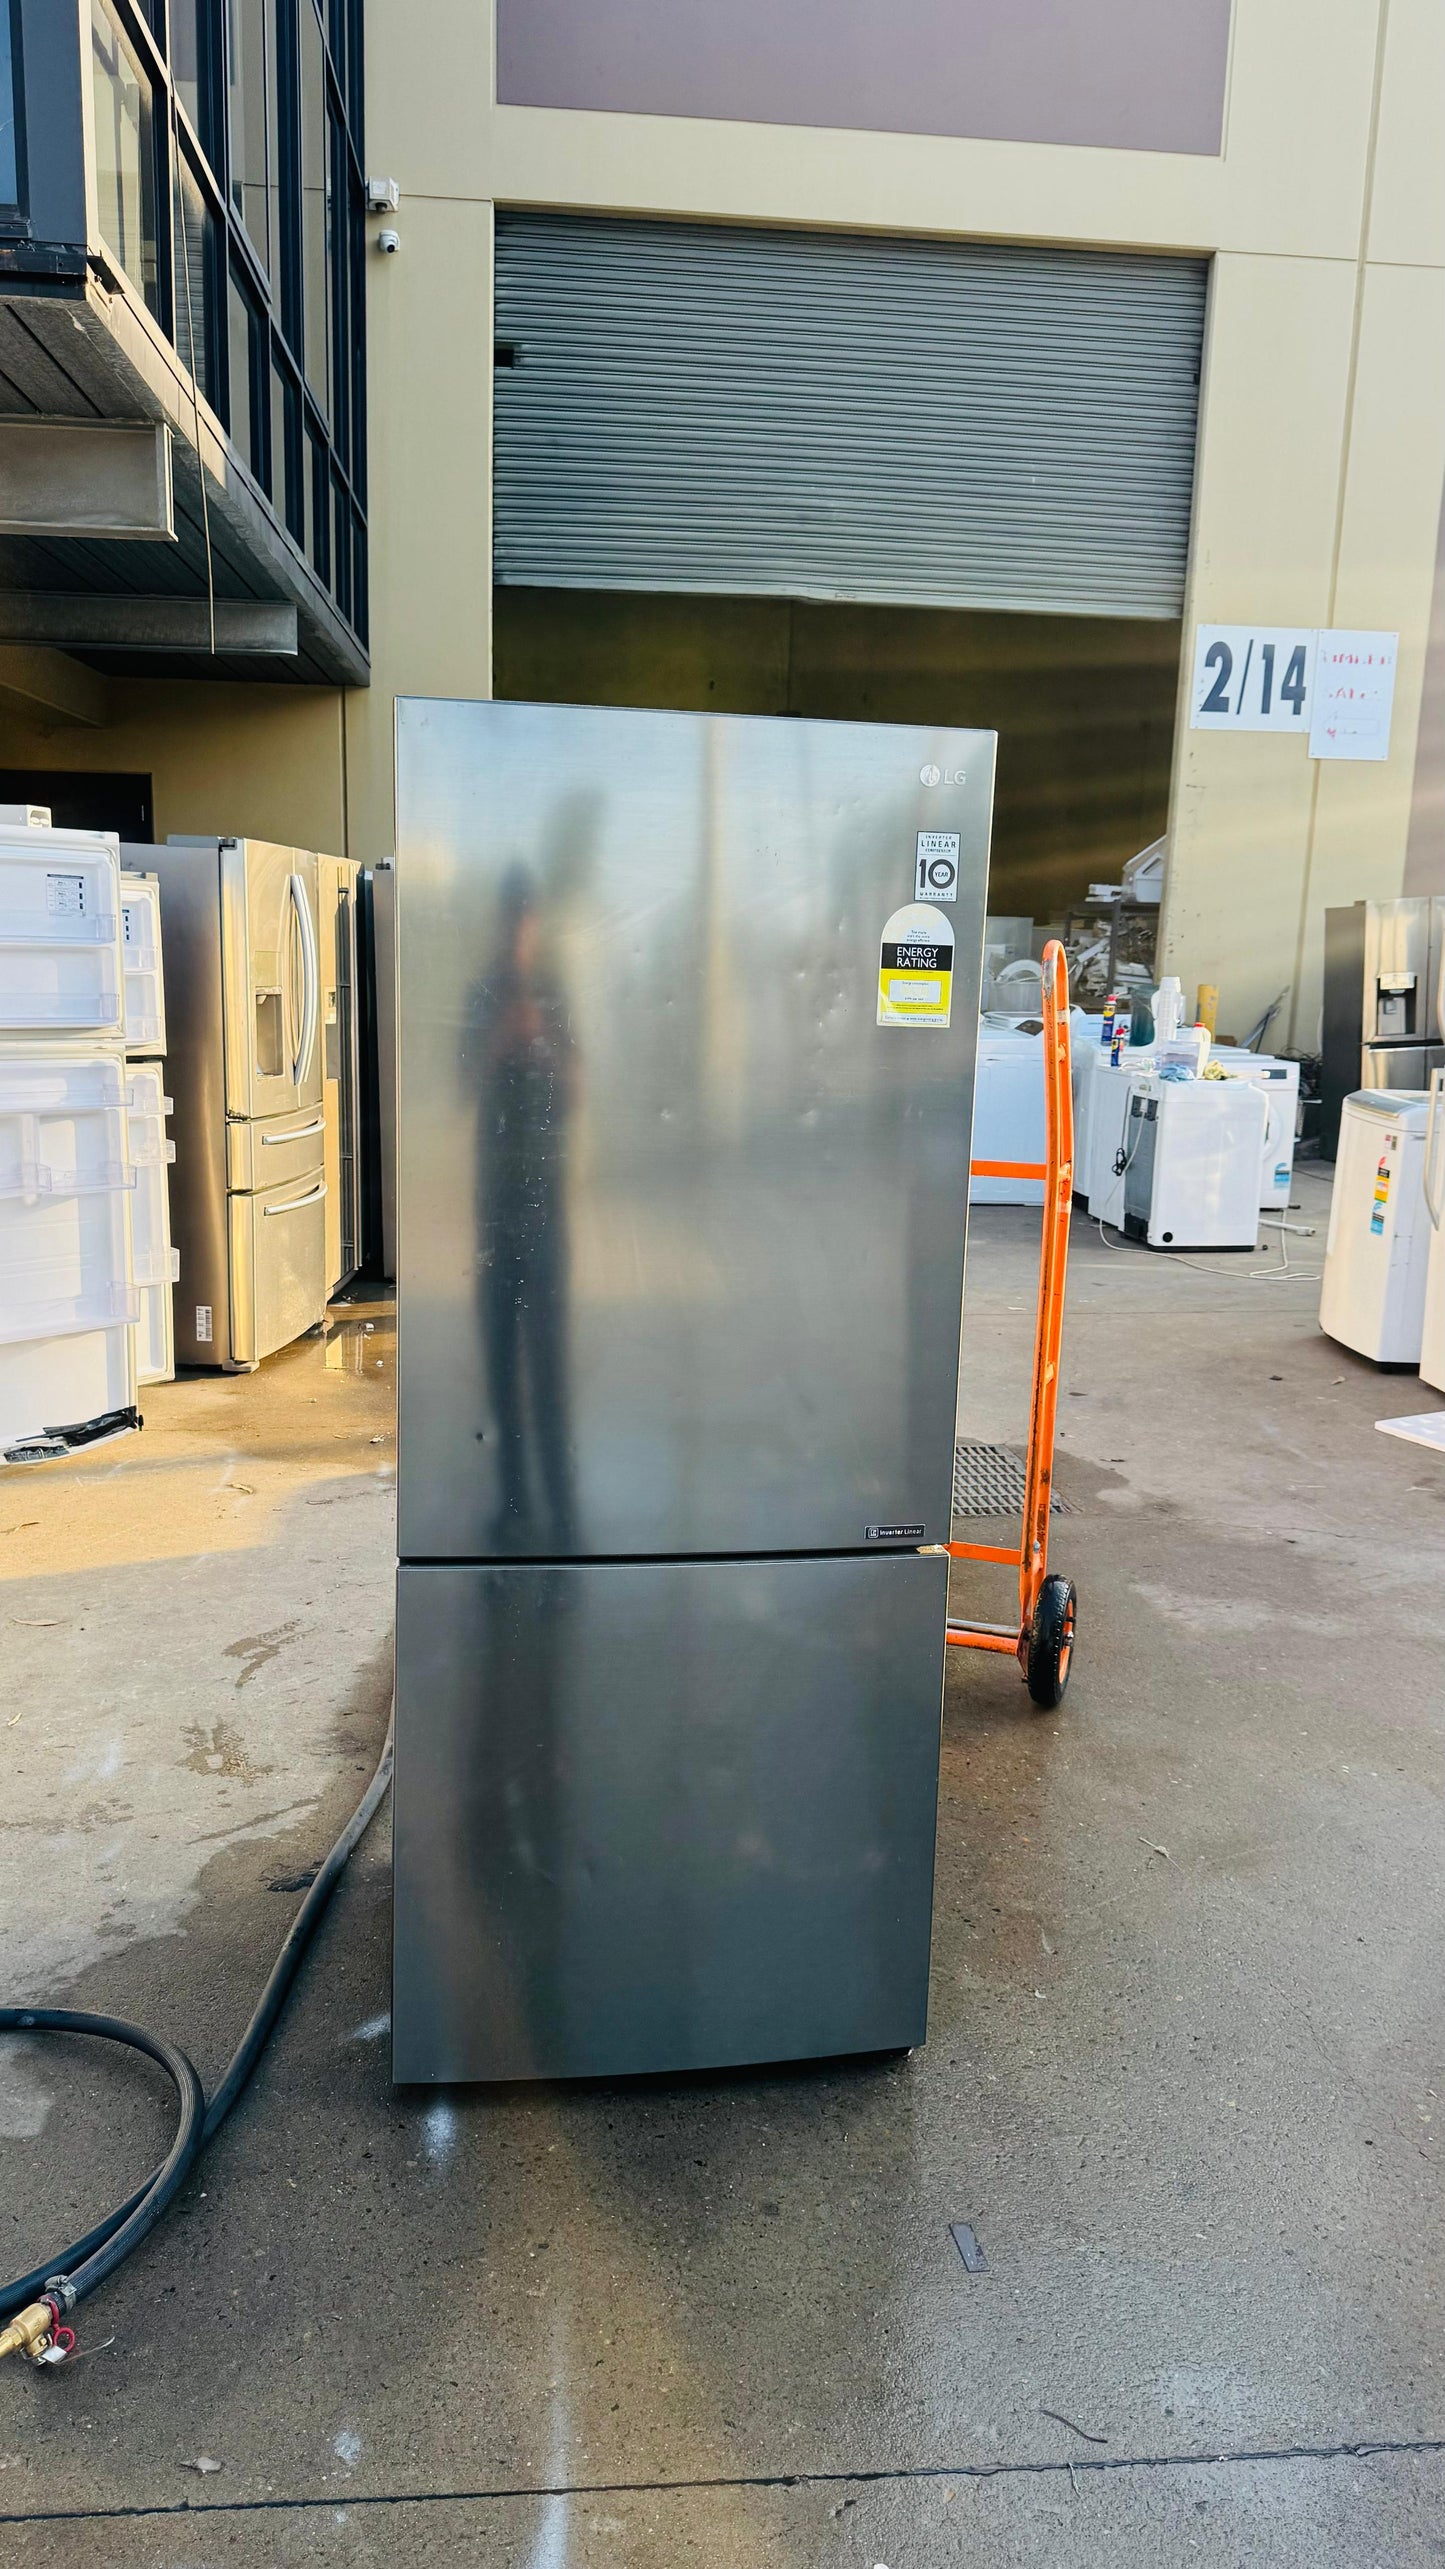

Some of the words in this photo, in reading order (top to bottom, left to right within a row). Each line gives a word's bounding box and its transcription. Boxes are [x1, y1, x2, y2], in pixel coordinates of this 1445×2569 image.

[1199, 639, 1307, 715] 2/14
[943, 769, 967, 785] LG
[921, 840, 956, 848] LINEAR
[919, 858, 956, 890] 10
[896, 946, 939, 958] ENERGY
[896, 957, 937, 968] RATING
